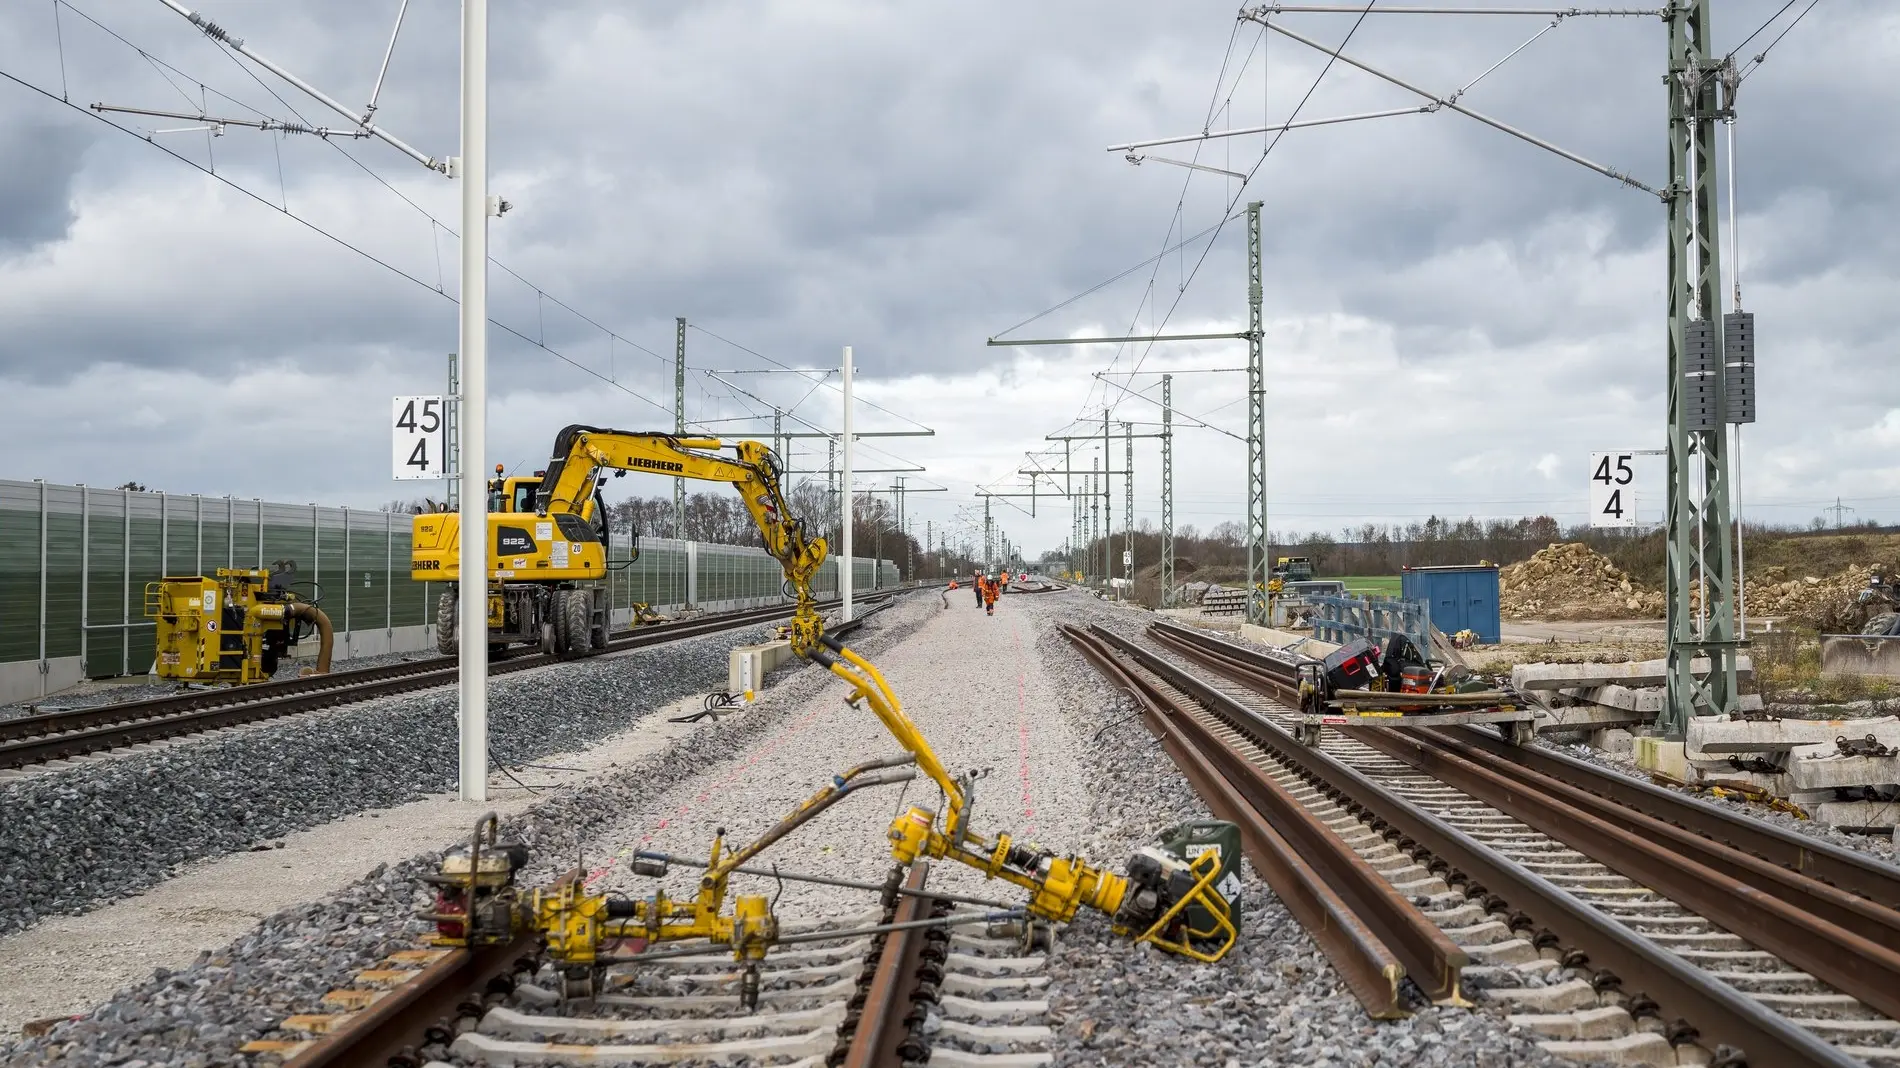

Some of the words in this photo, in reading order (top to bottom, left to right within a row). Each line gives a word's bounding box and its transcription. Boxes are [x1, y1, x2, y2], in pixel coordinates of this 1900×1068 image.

[396, 400, 440, 433] 45
[406, 438, 429, 471] 4
[627, 456, 684, 472] LIEBHERR
[1592, 455, 1633, 485] 45
[1602, 489, 1624, 518] 4
[573, 544, 581, 552] 20
